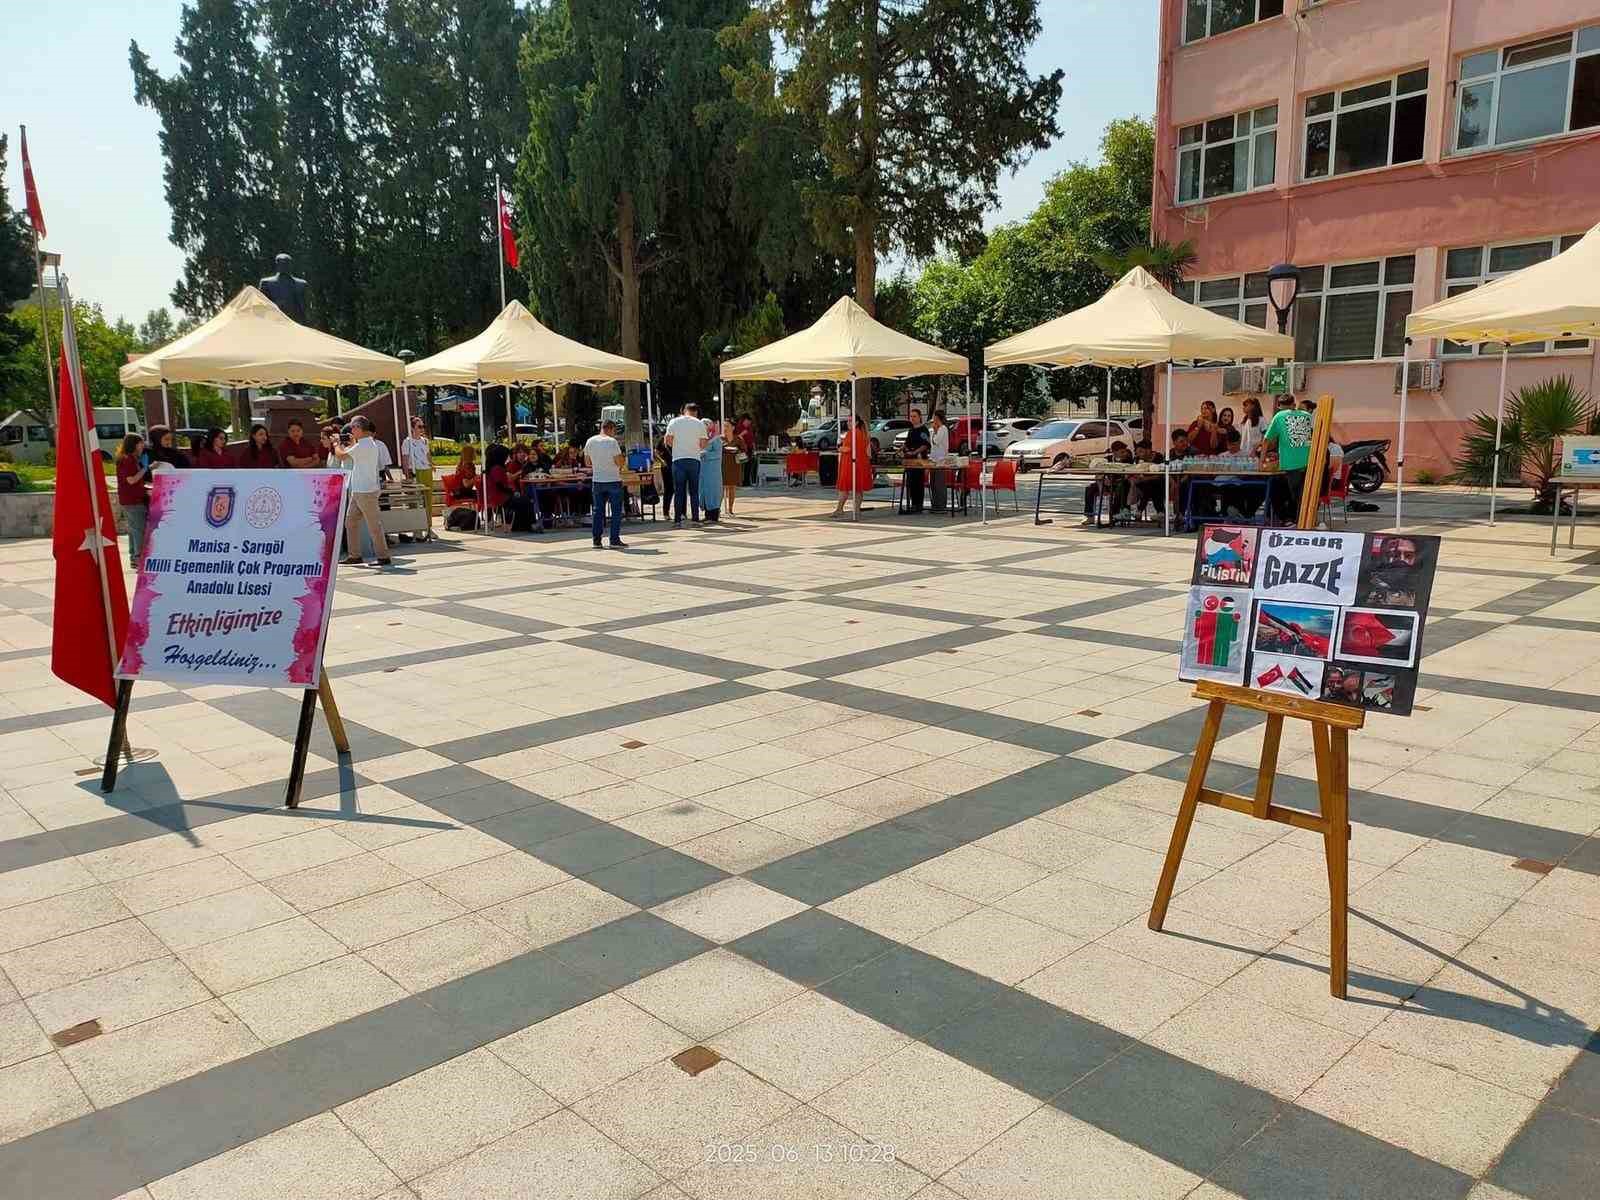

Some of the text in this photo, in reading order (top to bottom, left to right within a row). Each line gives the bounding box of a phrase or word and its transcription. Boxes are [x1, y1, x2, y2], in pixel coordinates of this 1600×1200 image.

[188, 539, 230, 553] Manisa
[242, 540, 285, 555] Sarıgöl
[146, 559, 322, 576] Milli Egemenlik Çok Programlı
[1263, 555, 1344, 596] GAZZE
[187, 580, 272, 595] Anadolu Lisesi
[166, 606, 283, 638] Etkinliğimize
